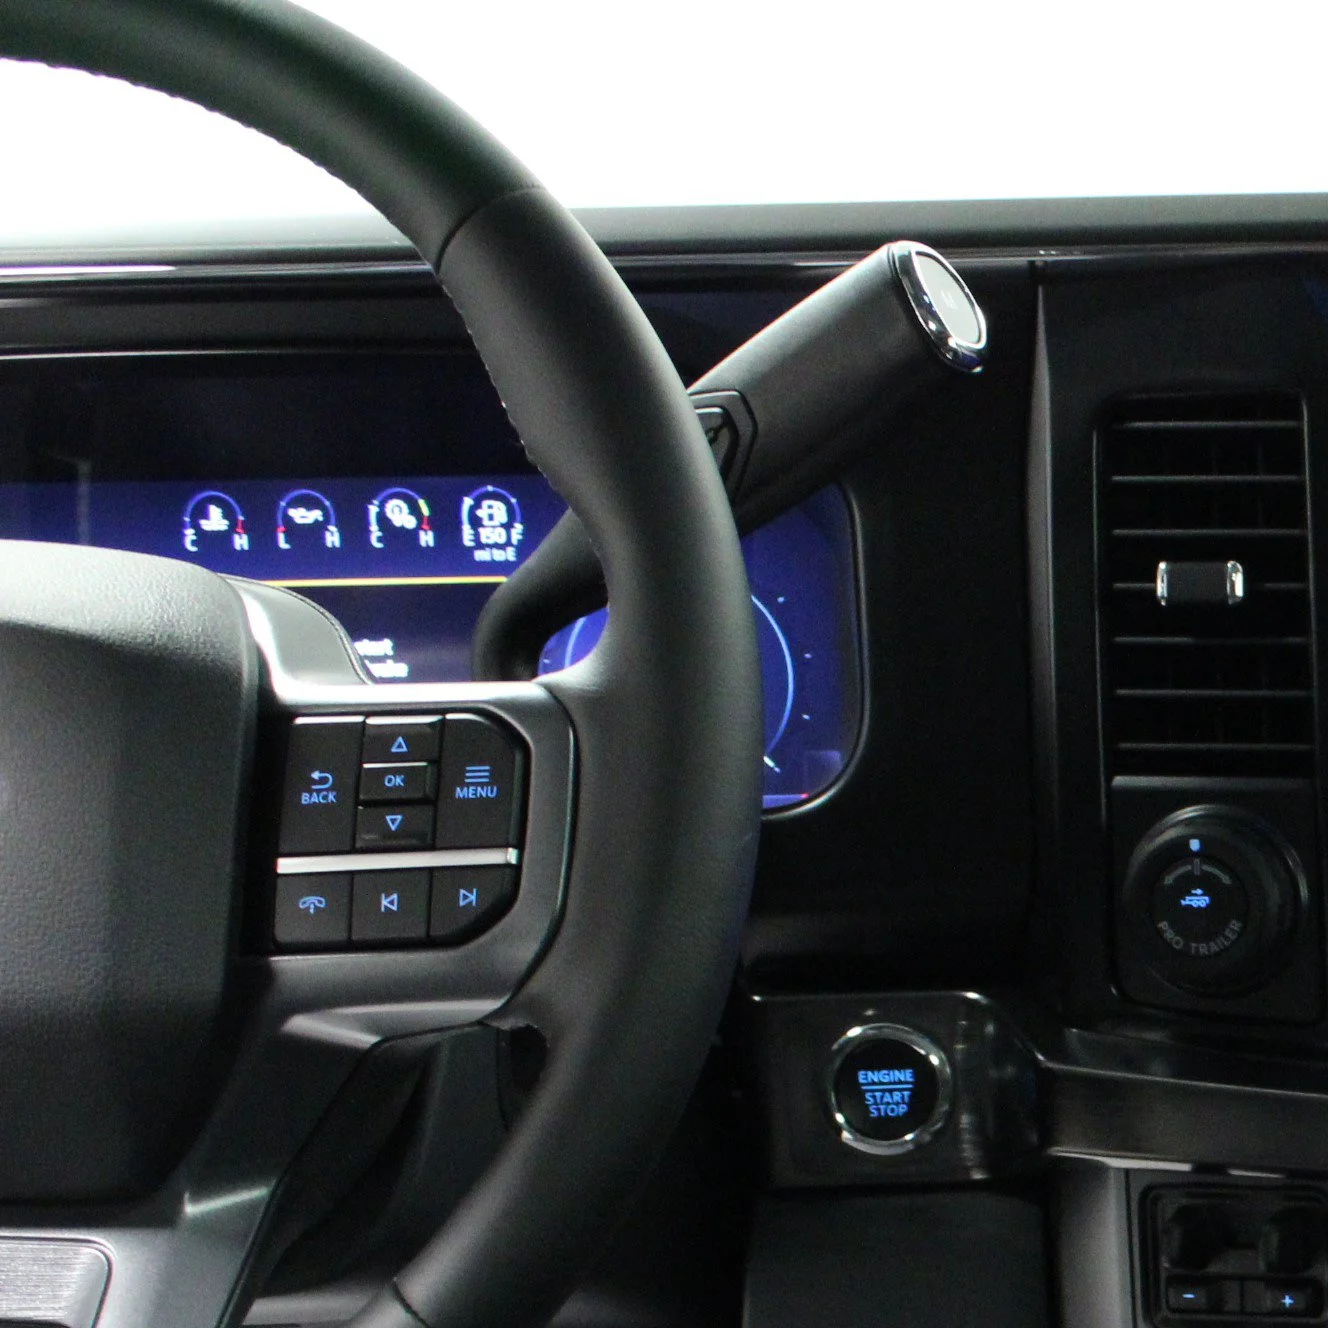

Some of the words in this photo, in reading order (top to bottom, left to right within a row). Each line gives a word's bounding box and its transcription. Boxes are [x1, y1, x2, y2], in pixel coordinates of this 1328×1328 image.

[384, 774, 404, 787] OK
[301, 791, 337, 805] BACK
[455, 786, 498, 799] MENU
[857, 1069, 915, 1084] ENGINE
[864, 1091, 911, 1105] START
[869, 1104, 908, 1118] STOP
